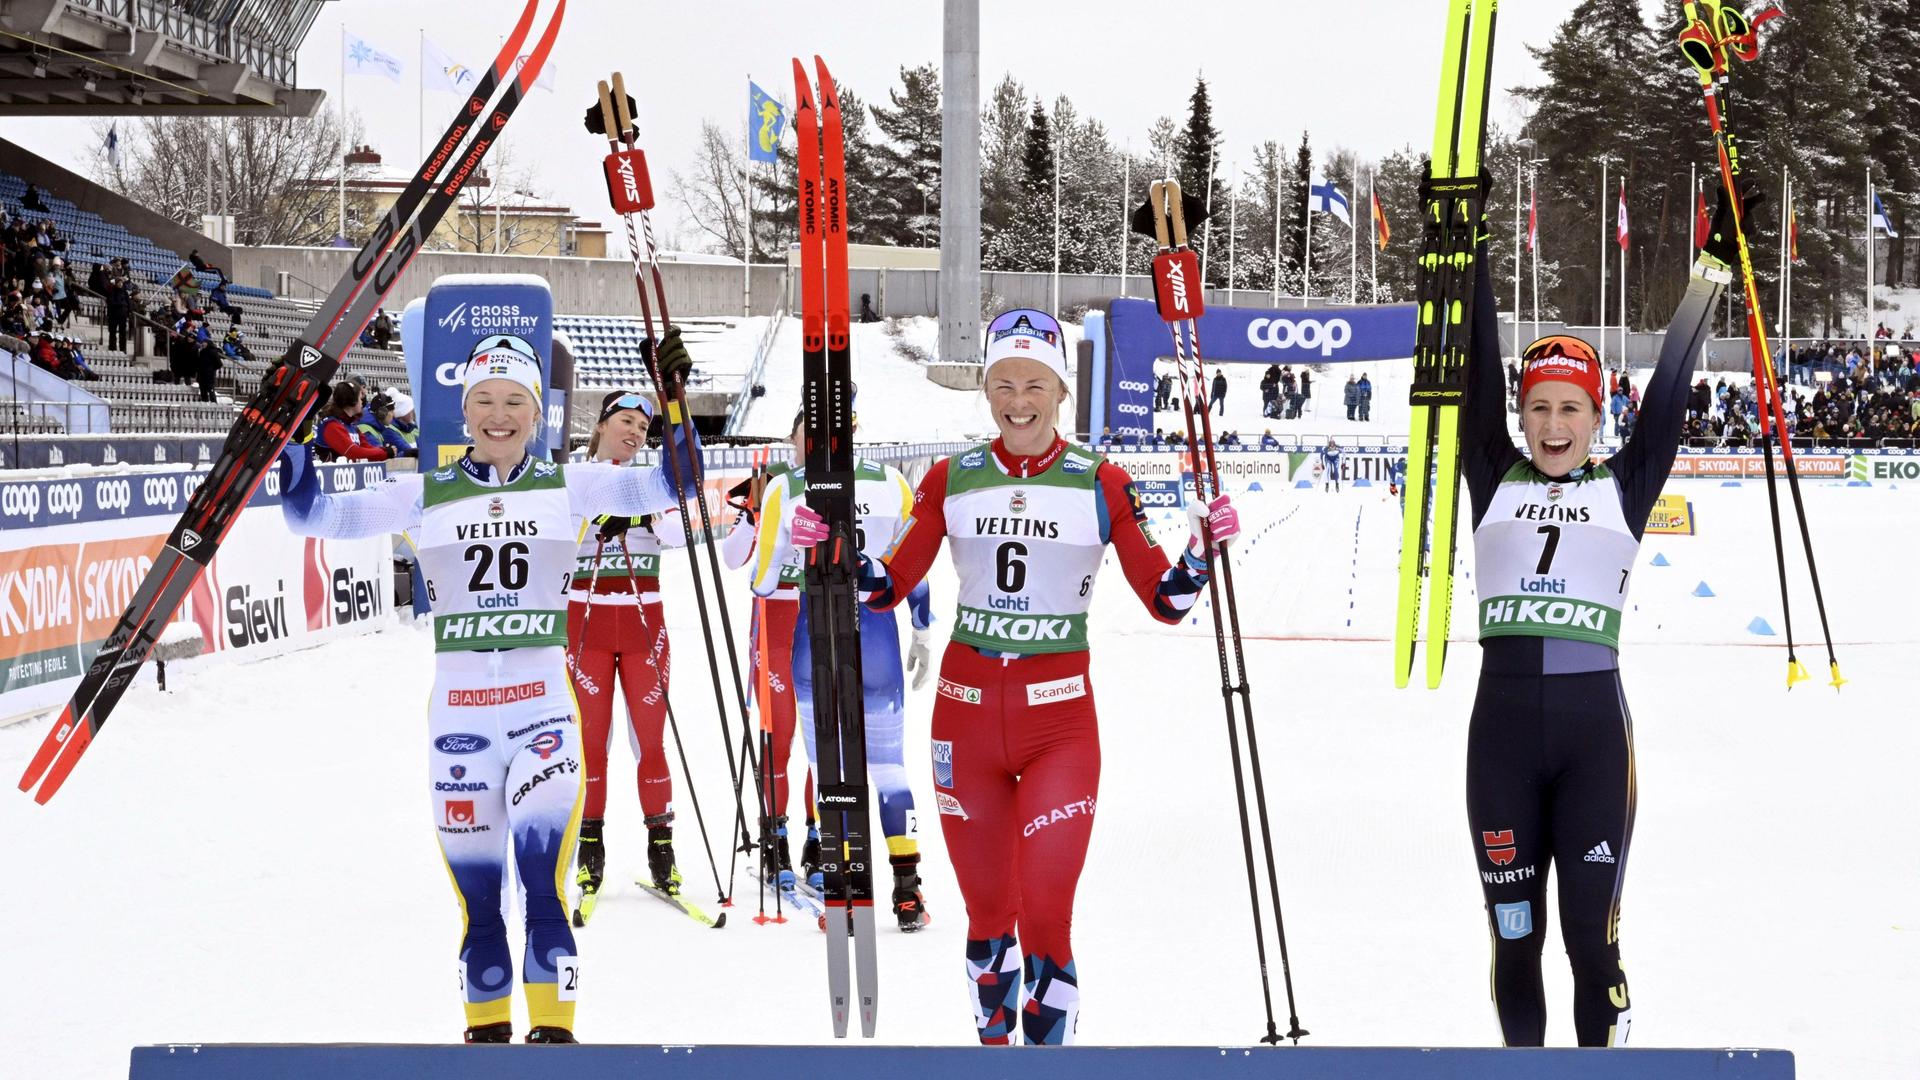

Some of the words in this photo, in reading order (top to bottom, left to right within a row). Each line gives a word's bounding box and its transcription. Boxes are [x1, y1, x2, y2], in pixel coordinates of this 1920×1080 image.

[422, 122, 467, 182] ROSSIGNOL
[1727, 134, 1740, 175] LEKI
[444, 137, 490, 197] ROSSIGNOL
[803, 179, 815, 235] ATOMIC
[828, 177, 840, 233] ATOMIC
[471, 305, 520, 316] CROSS
[471, 316, 538, 327] COUNTRY
[1247, 317, 1351, 356] coop
[491, 354, 528, 366] SVENSKA
[1119, 380, 1149, 393] coop
[1412, 390, 1463, 398] FISCHER
[548, 404, 564, 433] oop
[1118, 403, 1148, 416] coop
[1216, 460, 1281, 478] Pihlajalinna
[1699, 460, 1740, 471] SKYDDA
[1798, 460, 1841, 472] SKYDDA
[811, 482, 842, 490] ATOMIC
[1145, 481, 1166, 490] 50m
[2, 484, 40, 522] coop
[48, 483, 83, 519] coop
[96, 480, 130, 514] coop
[144, 477, 177, 510] coop
[1141, 492, 1176, 507] oop
[1515, 503, 1590, 522] VELTINS
[456, 520, 538, 540] VELTINS
[976, 517, 1059, 539] VELTINS
[464, 542, 530, 592] 26
[996, 541, 1028, 593] 6
[1079, 575, 1092, 597] 6
[1520, 577, 1566, 594] Lahti
[1618, 568, 1628, 594] 7
[0, 565, 72, 637] KYDDA
[333, 567, 382, 625] Sievi
[477, 593, 518, 609] Lahti
[988, 594, 1029, 612] Lahti
[226, 579, 290, 648] Sievi
[1485, 600, 1606, 631] HiKOKI
[442, 614, 555, 639] HiKOKI
[958, 610, 1071, 641] HiKOKI
[449, 682, 545, 706] BAUHAUS
[938, 682, 964, 698] PAR
[1033, 682, 1080, 699] Scandic
[507, 716, 567, 739] Sundström
[442, 737, 476, 751] Ford
[435, 781, 489, 792] SCANIA
[512, 761, 565, 806] CRAFT
[472, 824, 490, 833] SPEL
[1023, 799, 1087, 838] CRAFT
[822, 863, 837, 872] C9
[849, 863, 864, 872] C9
[1584, 853, 1615, 864] adidas
[565, 966, 578, 991] 2
